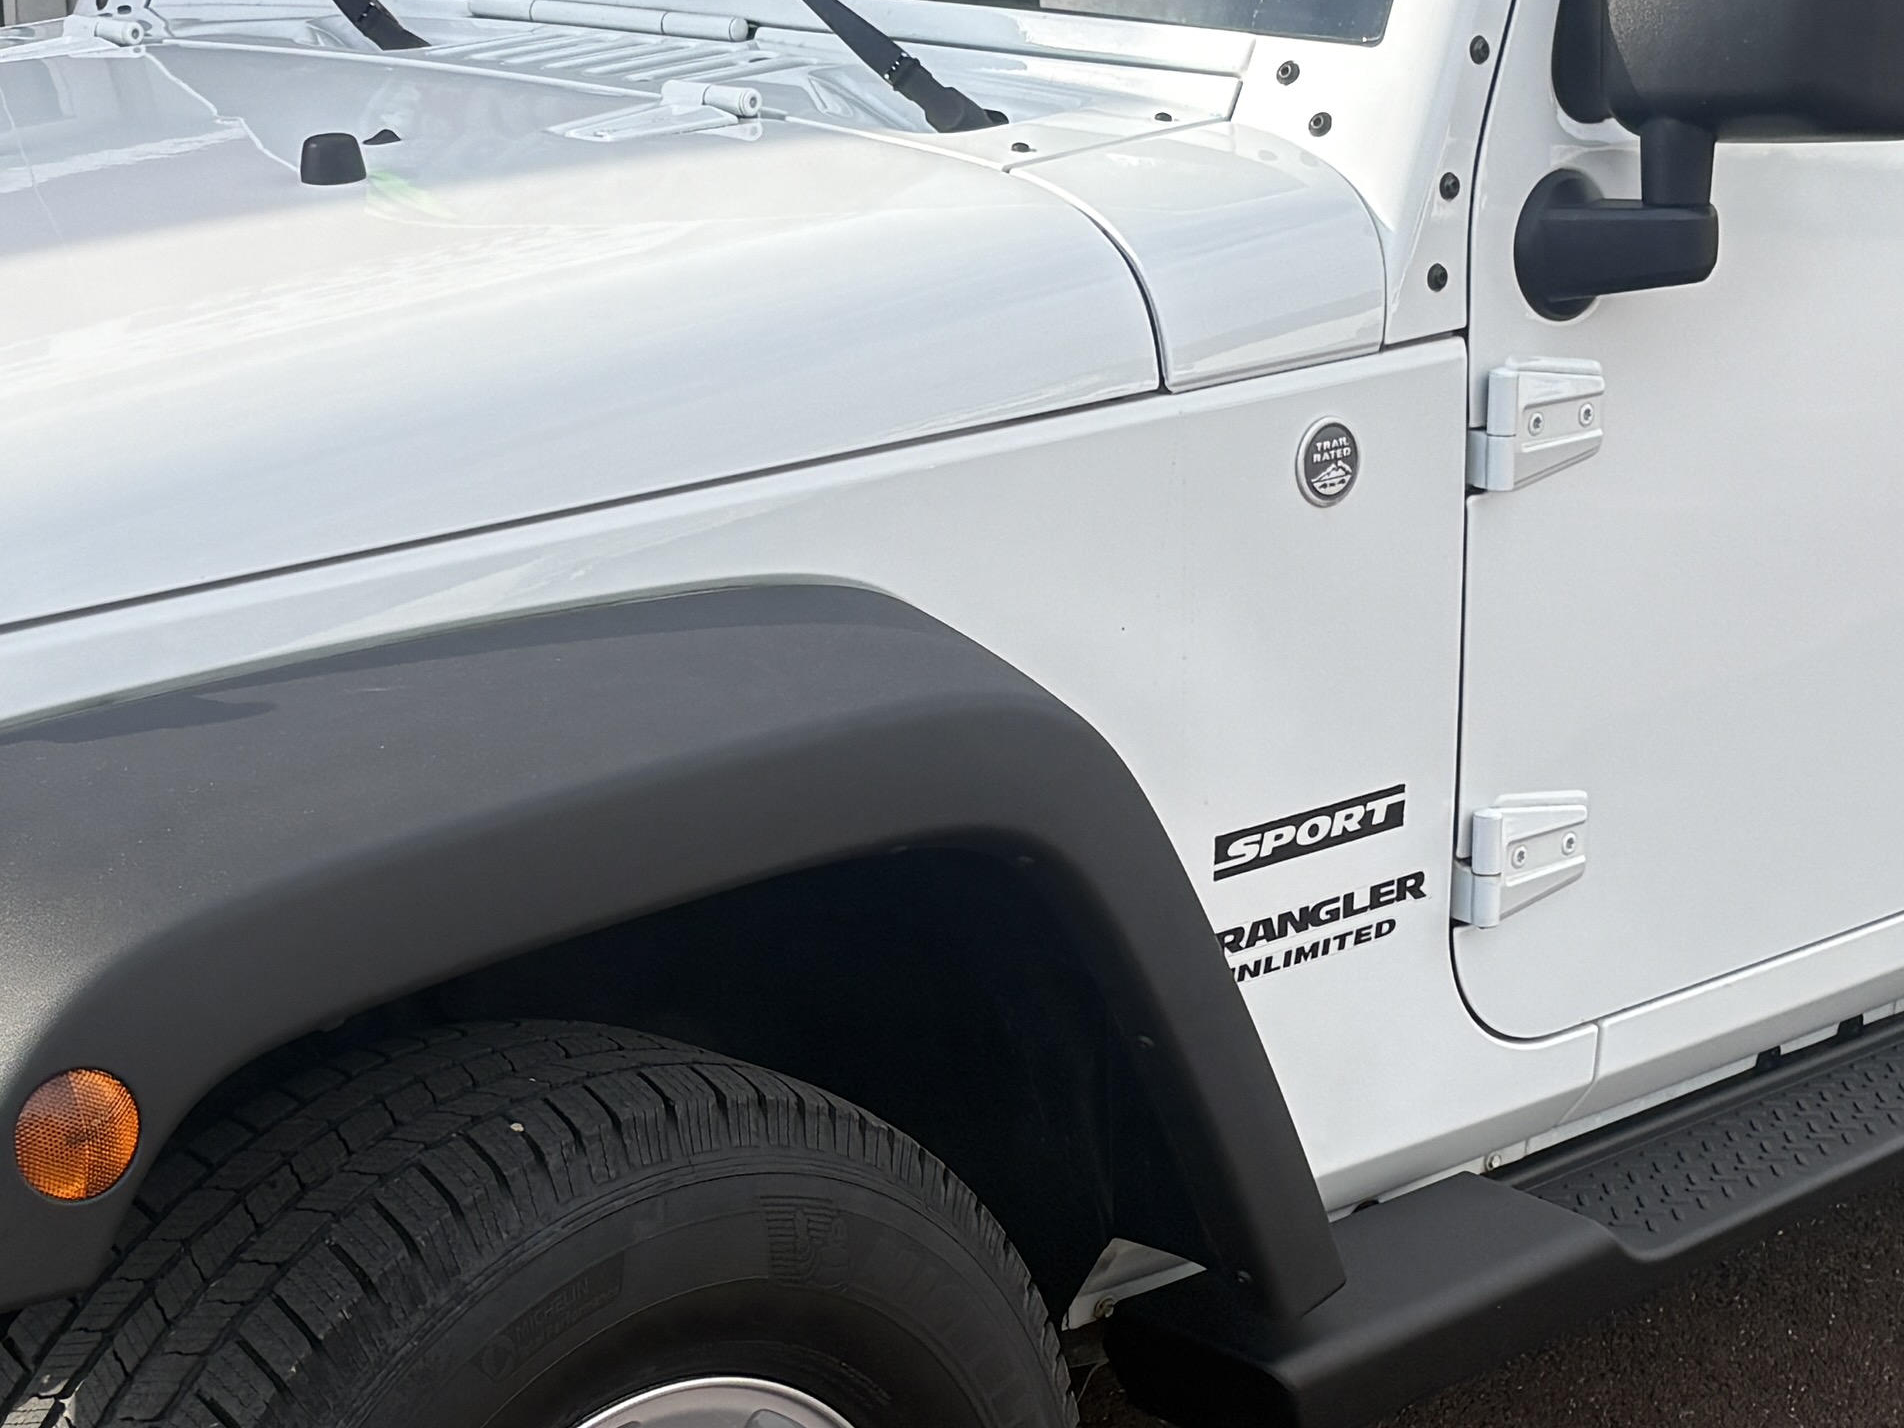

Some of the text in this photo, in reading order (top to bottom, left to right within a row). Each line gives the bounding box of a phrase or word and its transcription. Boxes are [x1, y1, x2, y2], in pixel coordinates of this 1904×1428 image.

[1313, 447, 1352, 463] RATED
[1315, 436, 1350, 452] TRAIL
[1216, 792, 1405, 870] SPORT
[1215, 871, 1428, 954] RANGLER
[1231, 918, 1396, 982] NLIMITED
